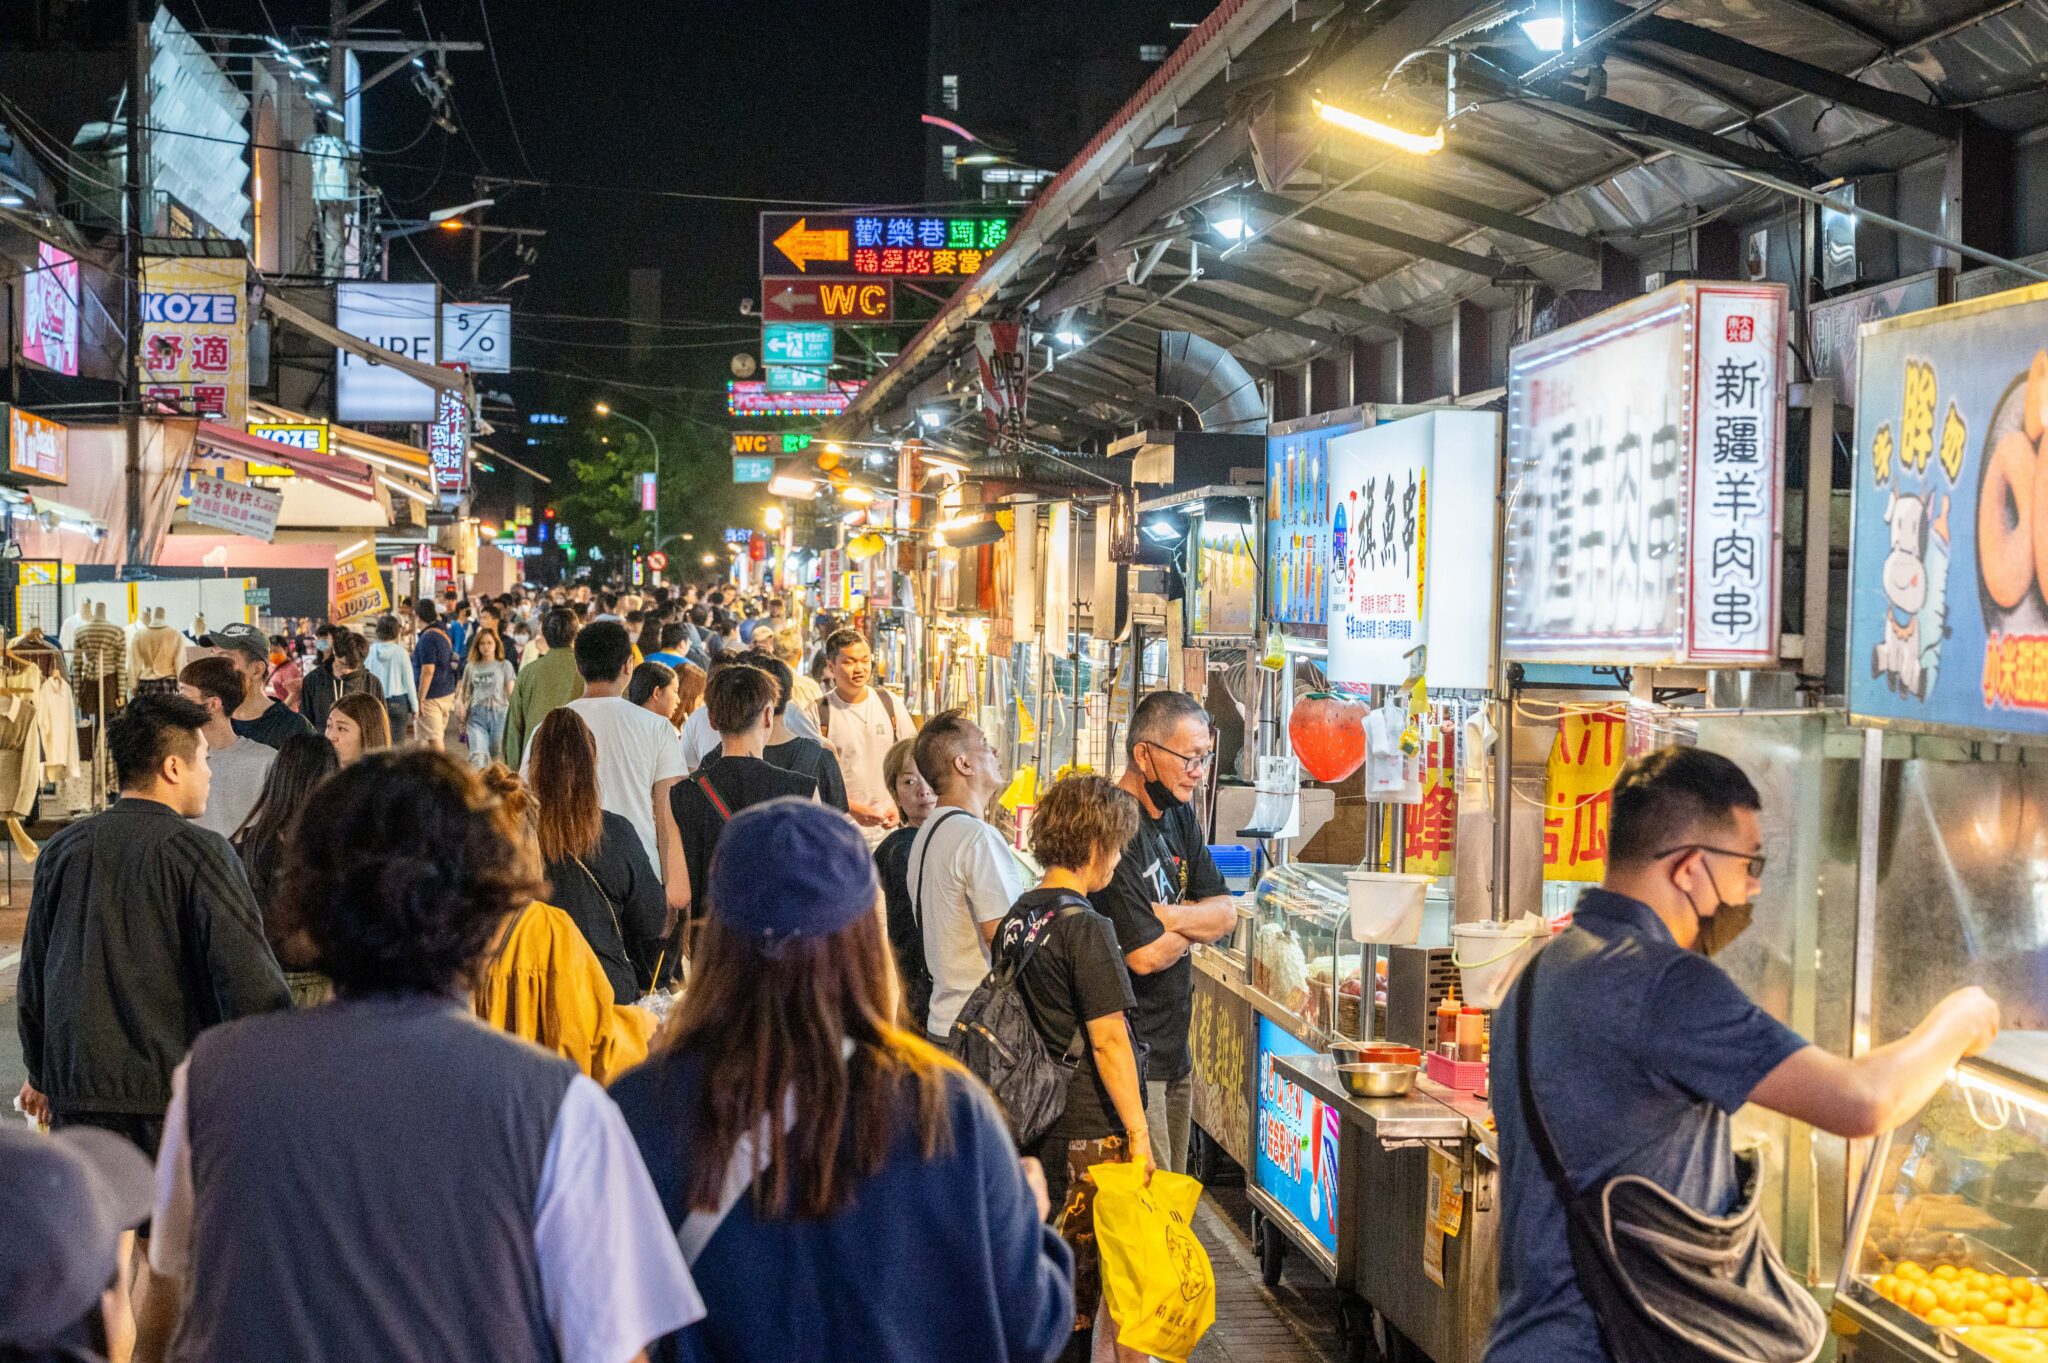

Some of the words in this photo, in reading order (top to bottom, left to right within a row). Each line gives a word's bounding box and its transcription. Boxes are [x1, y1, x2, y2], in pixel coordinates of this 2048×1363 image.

[140, 294, 236, 323] KOZE
[819, 285, 887, 315] WC
[147, 335, 229, 372] 舒適
[735, 435, 768, 453] WC
[1713, 356, 1761, 636] 新疆羊肉串
[1358, 467, 1417, 580] 旗魚串
